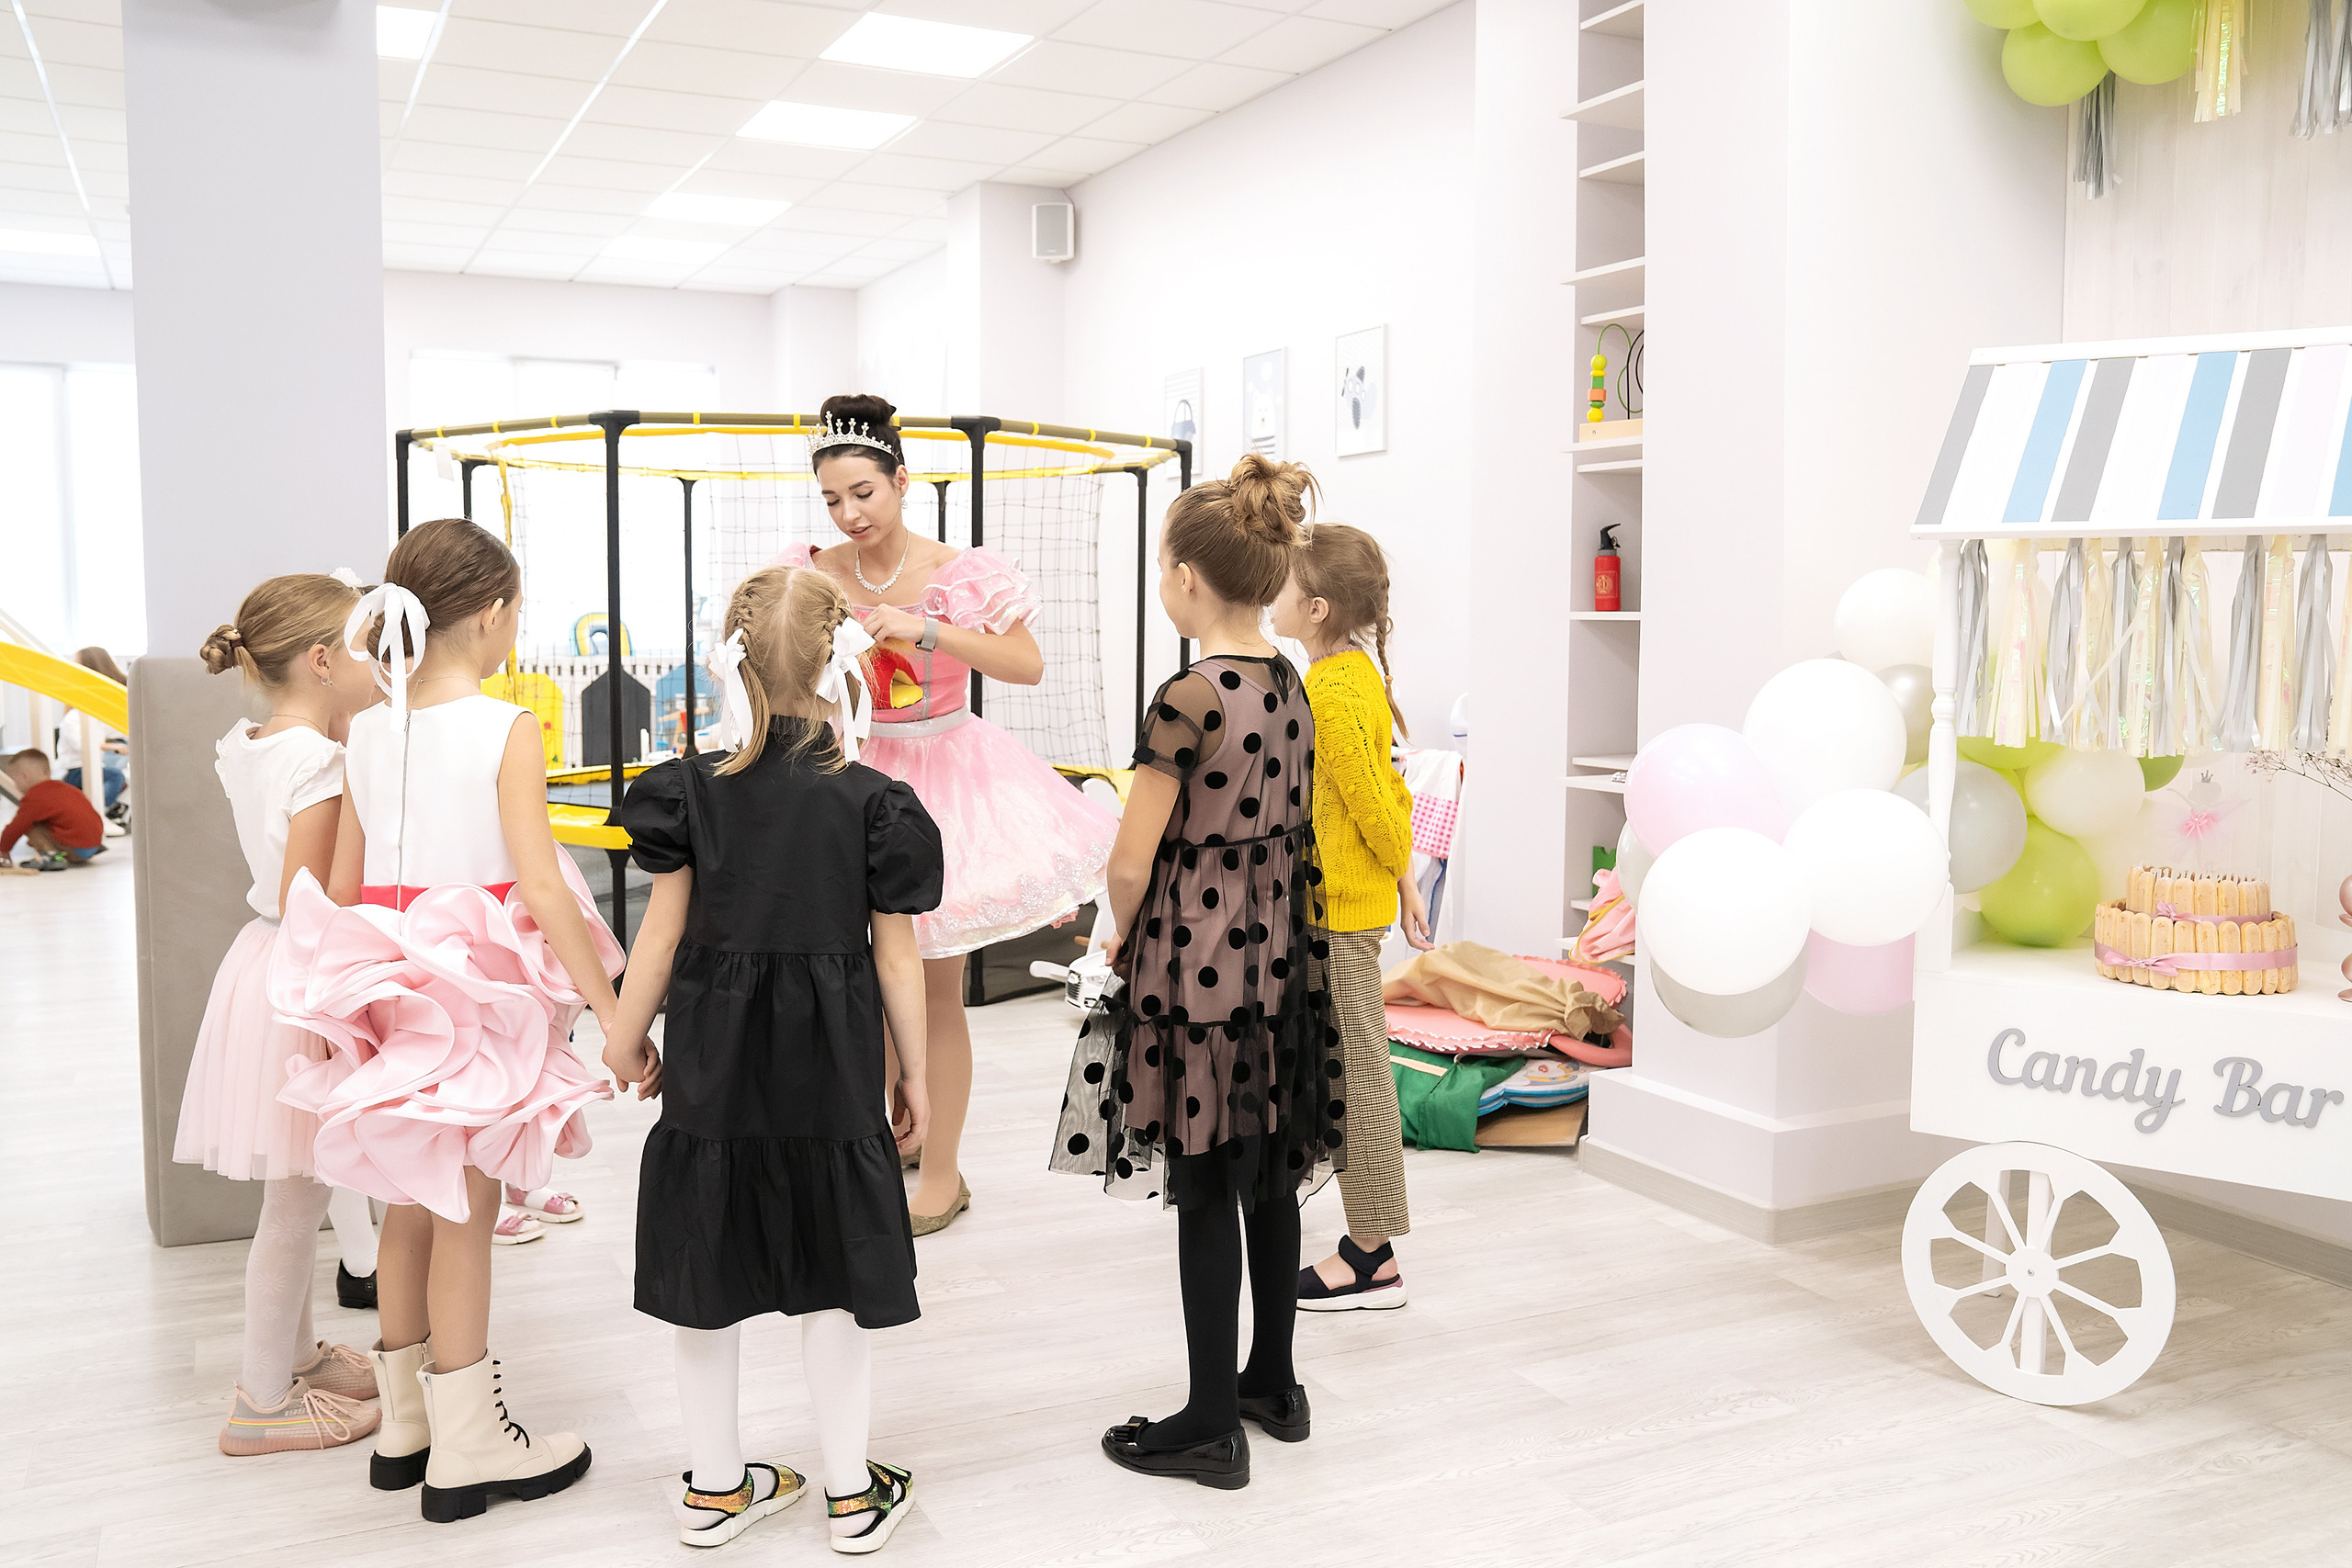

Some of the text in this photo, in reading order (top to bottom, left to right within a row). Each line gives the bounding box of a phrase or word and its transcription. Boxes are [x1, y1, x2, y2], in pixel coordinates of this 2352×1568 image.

[1988, 1028, 2345, 1134] Candy Bar
[285, 1407, 309, 1416] 198
